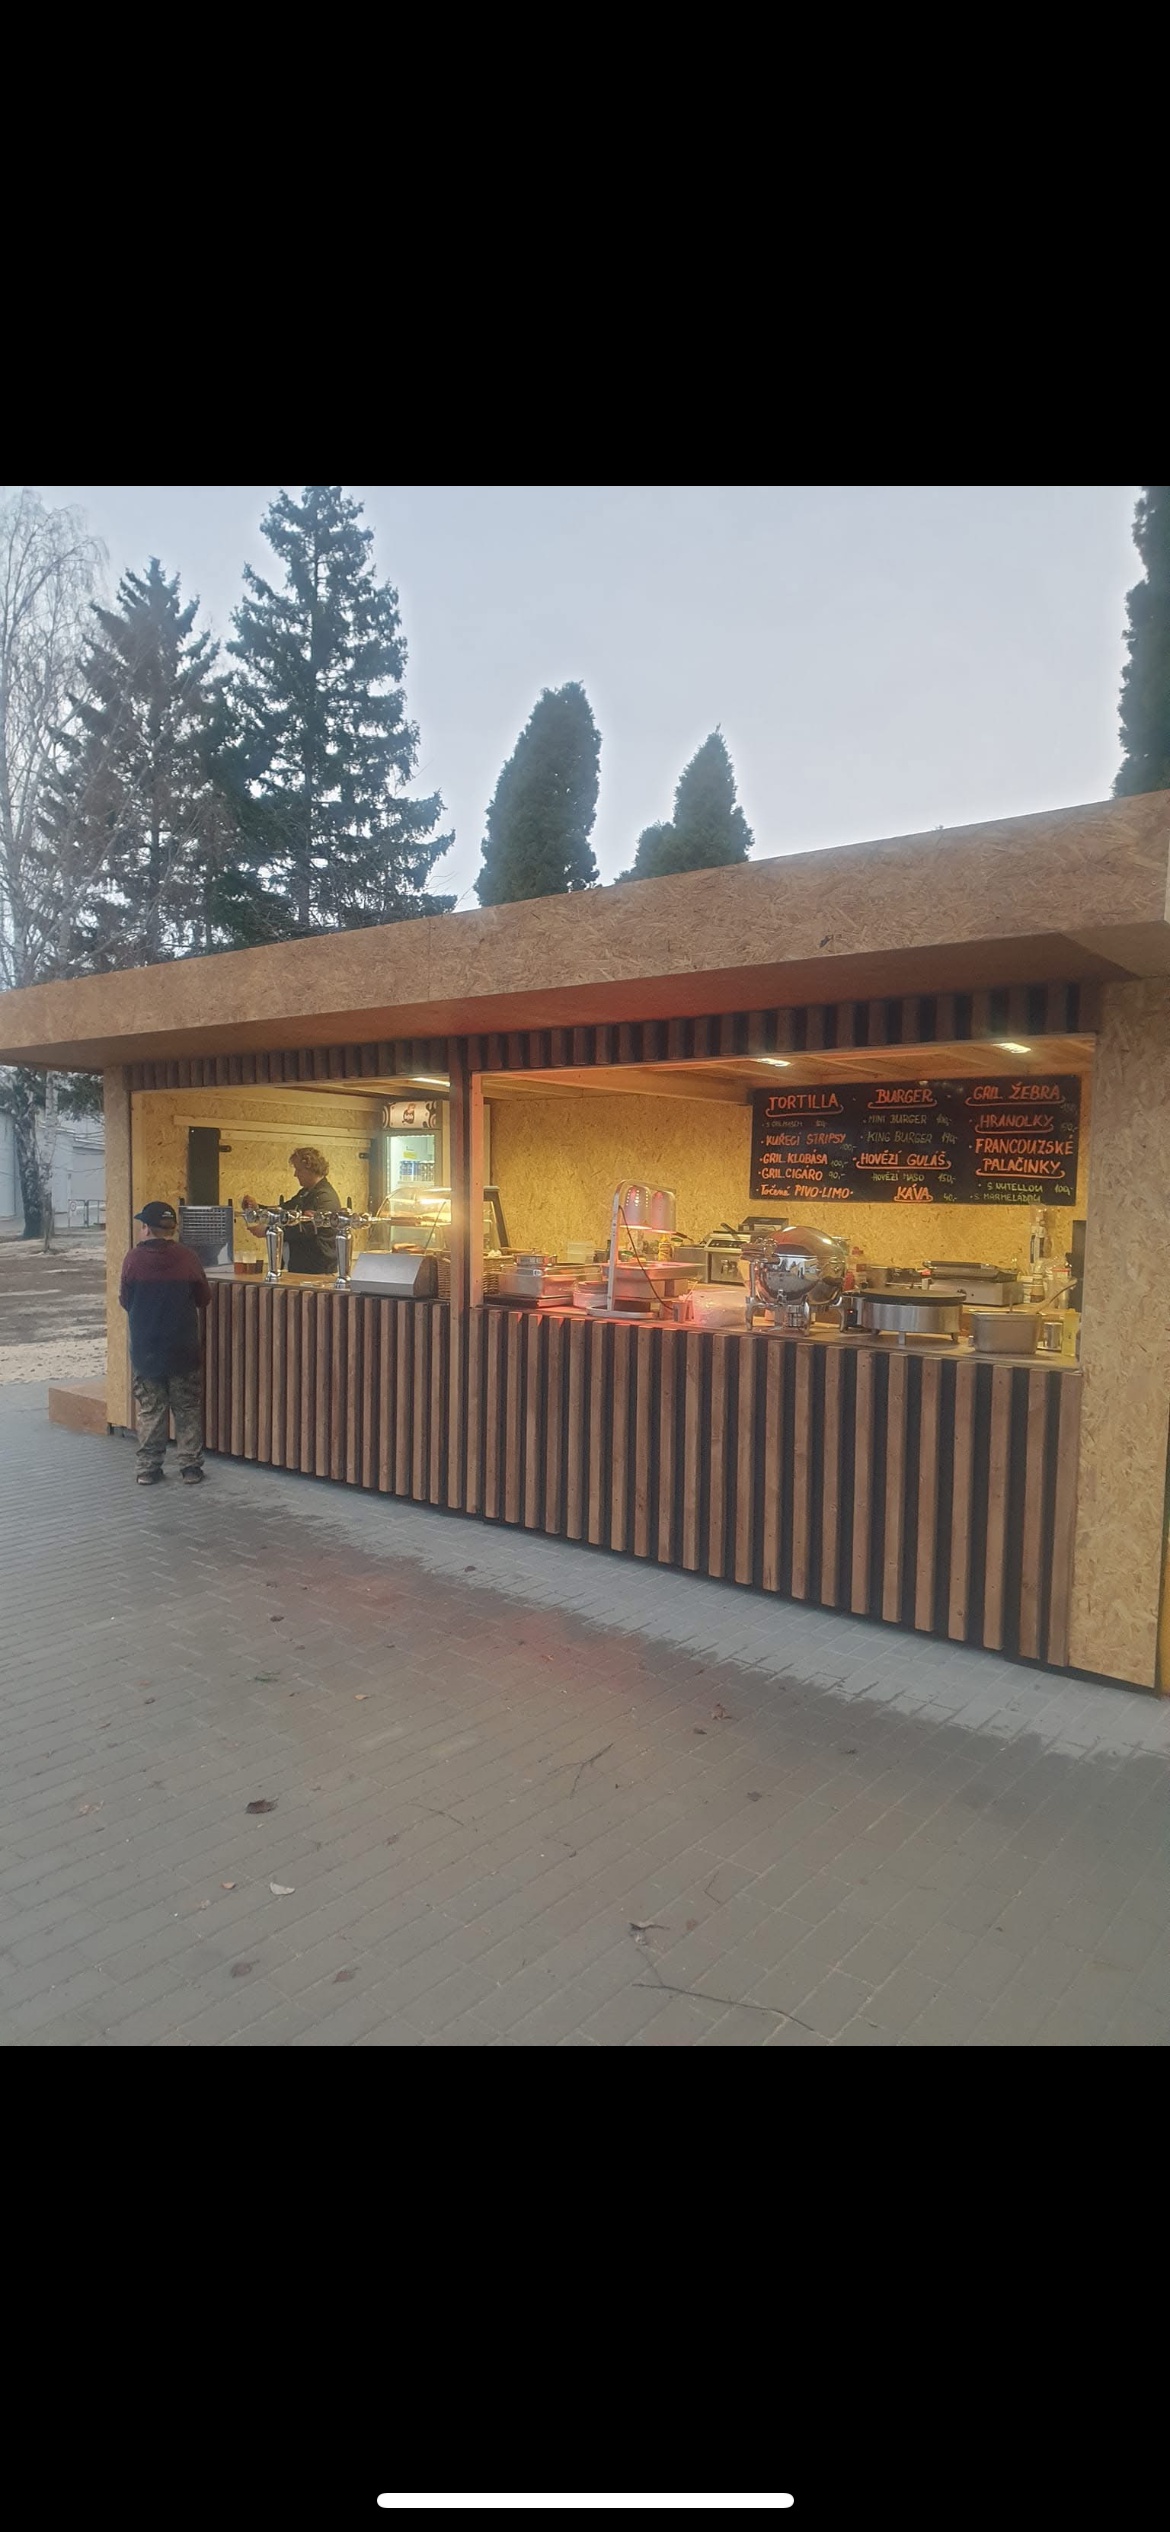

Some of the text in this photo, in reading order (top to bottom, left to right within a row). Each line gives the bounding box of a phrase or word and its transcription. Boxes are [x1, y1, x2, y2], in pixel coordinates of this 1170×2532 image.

[875, 1089, 934, 1104] BURGER
[1009, 1081, 1060, 1100] ŽEBRA
[769, 1093, 839, 1111] TORTILLA
[890, 1114, 927, 1124] BURGER
[980, 1114, 1054, 1128] HRANOLKY
[806, 1133, 847, 1145] STRIPSY
[867, 1131, 890, 1142] KING
[894, 1131, 933, 1143] BURGER
[975, 1134, 1074, 1155] FRANCOUZSKÉ
[787, 1148, 829, 1165] KLOBÁSA
[906, 1150, 947, 1166] GULÁŠ
[785, 1165, 824, 1181] CIGÁRO
[982, 1156, 1061, 1174] PALAČINKY
[897, 1183, 931, 1201] KÁVA
